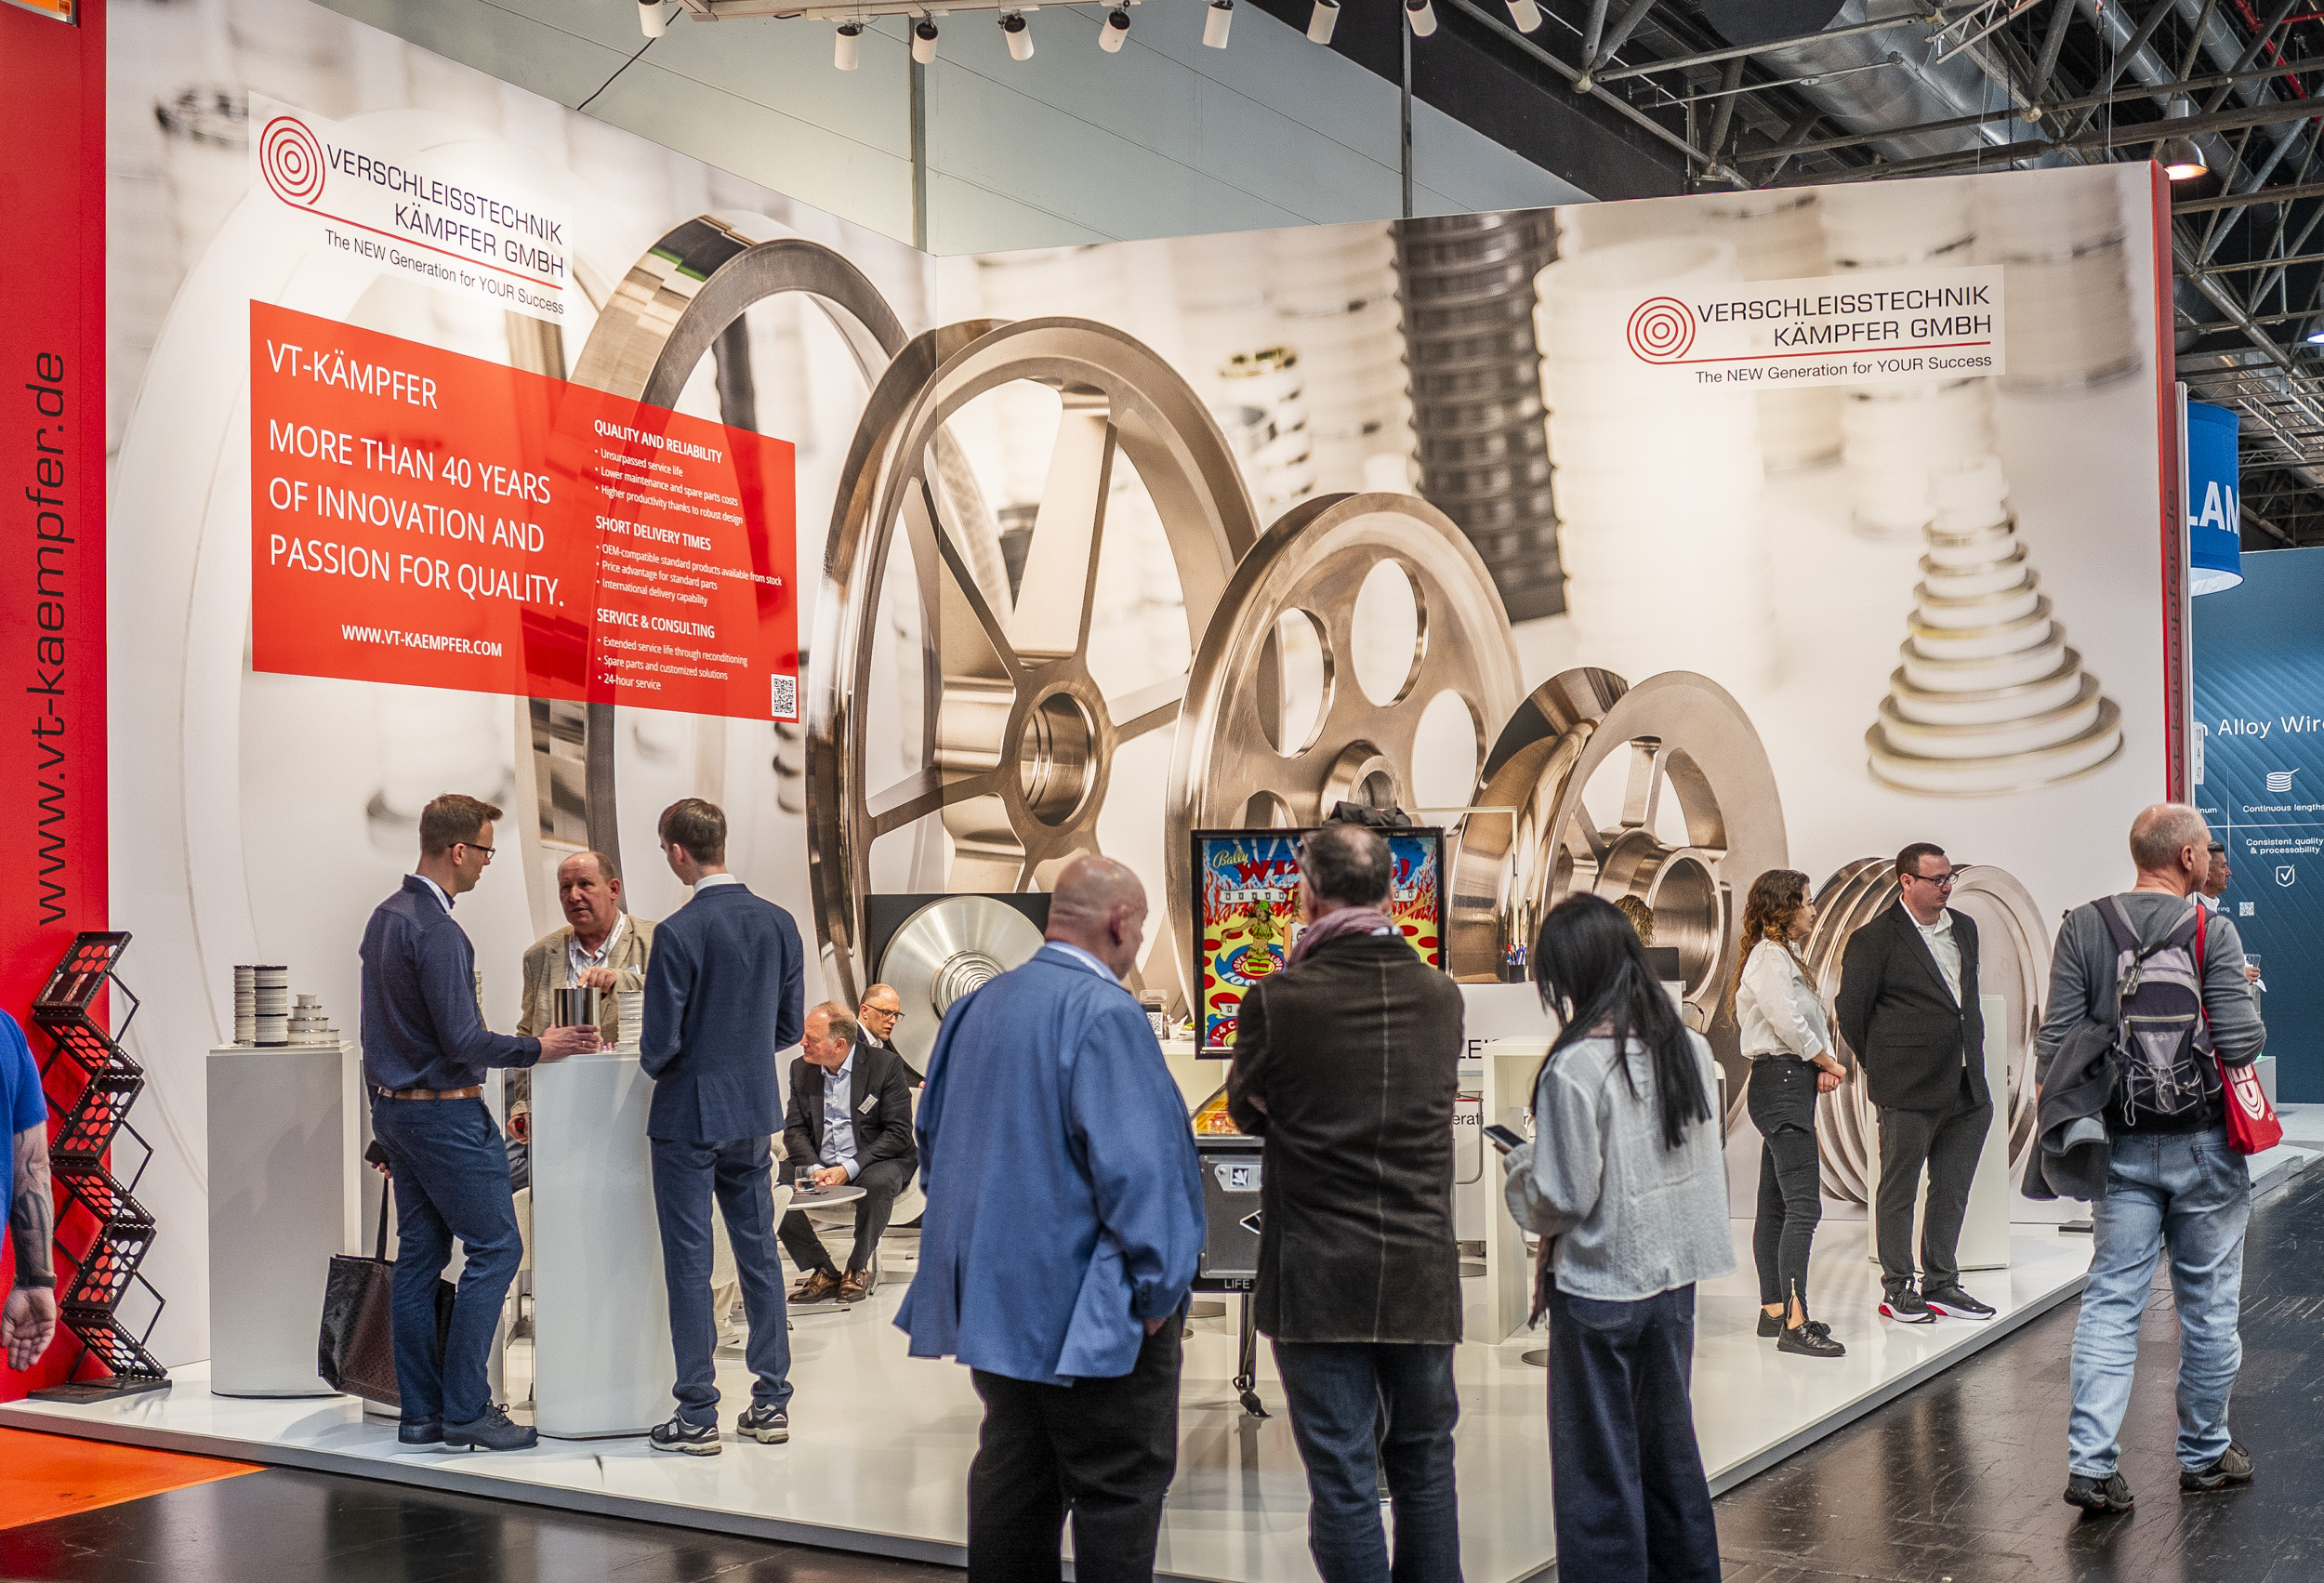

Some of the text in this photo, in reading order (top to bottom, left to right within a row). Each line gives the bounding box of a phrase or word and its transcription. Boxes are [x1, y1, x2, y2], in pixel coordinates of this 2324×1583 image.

[326, 144, 562, 245] VERSCHLEISSTECHNIK
[395, 202, 564, 278] KÄMPFER GMBH
[325, 229, 564, 314] The NEW Generation for YOUR Success
[1697, 285, 1990, 323] VERSCHLEISSTECHNIK
[1775, 314, 1991, 348] KÄMPFER GMBH
[267, 338, 438, 410] VT-KÄMPFER
[1696, 355, 1992, 384] The NEW Generation for YOUR Success
[594, 419, 722, 464] QUALITY AND RELIABILITY
[269, 418, 551, 505] MORE THAN 40 YEARS
[601, 448, 683, 477] Unsurpassed service life
[601, 467, 738, 507] Lower maintenance and spare parts costs
[269, 477, 545, 553] OF INNOVATION AND
[601, 485, 744, 526] Higher productivity thanks to robust design
[595, 515, 711, 551] SHORT DELIVERY TIMES
[270, 534, 564, 608] PASSION FOR QUALITY.
[601, 544, 783, 587] OEM-compatible standard products available from stock
[602, 561, 718, 590] Price advantage for standard parts
[602, 578, 708, 608] International delivery capability
[25, 351, 75, 926] www.vt-kaempfer.de
[597, 608, 716, 640] SERVICE & CONSULTING
[341, 624, 503, 657] WWW.VT-KAEMPFER.COM
[603, 637, 748, 667] Extended service life through reconditioning
[603, 655, 728, 680] Spare parts and customized solutions
[603, 674, 661, 691] 24-hour service
[2218, 719, 2272, 739] Alloy
[2280, 716, 2324, 733] Wir
[2242, 804, 2291, 813] Continuous
[1212, 848, 1249, 869] Bally
[2246, 838, 2324, 848] Consistent quality
[2260, 846, 2320, 856] processability
[1233, 955, 1247, 972] LOVE
[1270, 955, 1283, 971] LOVE
[1224, 1279, 1250, 1289] LIFE
